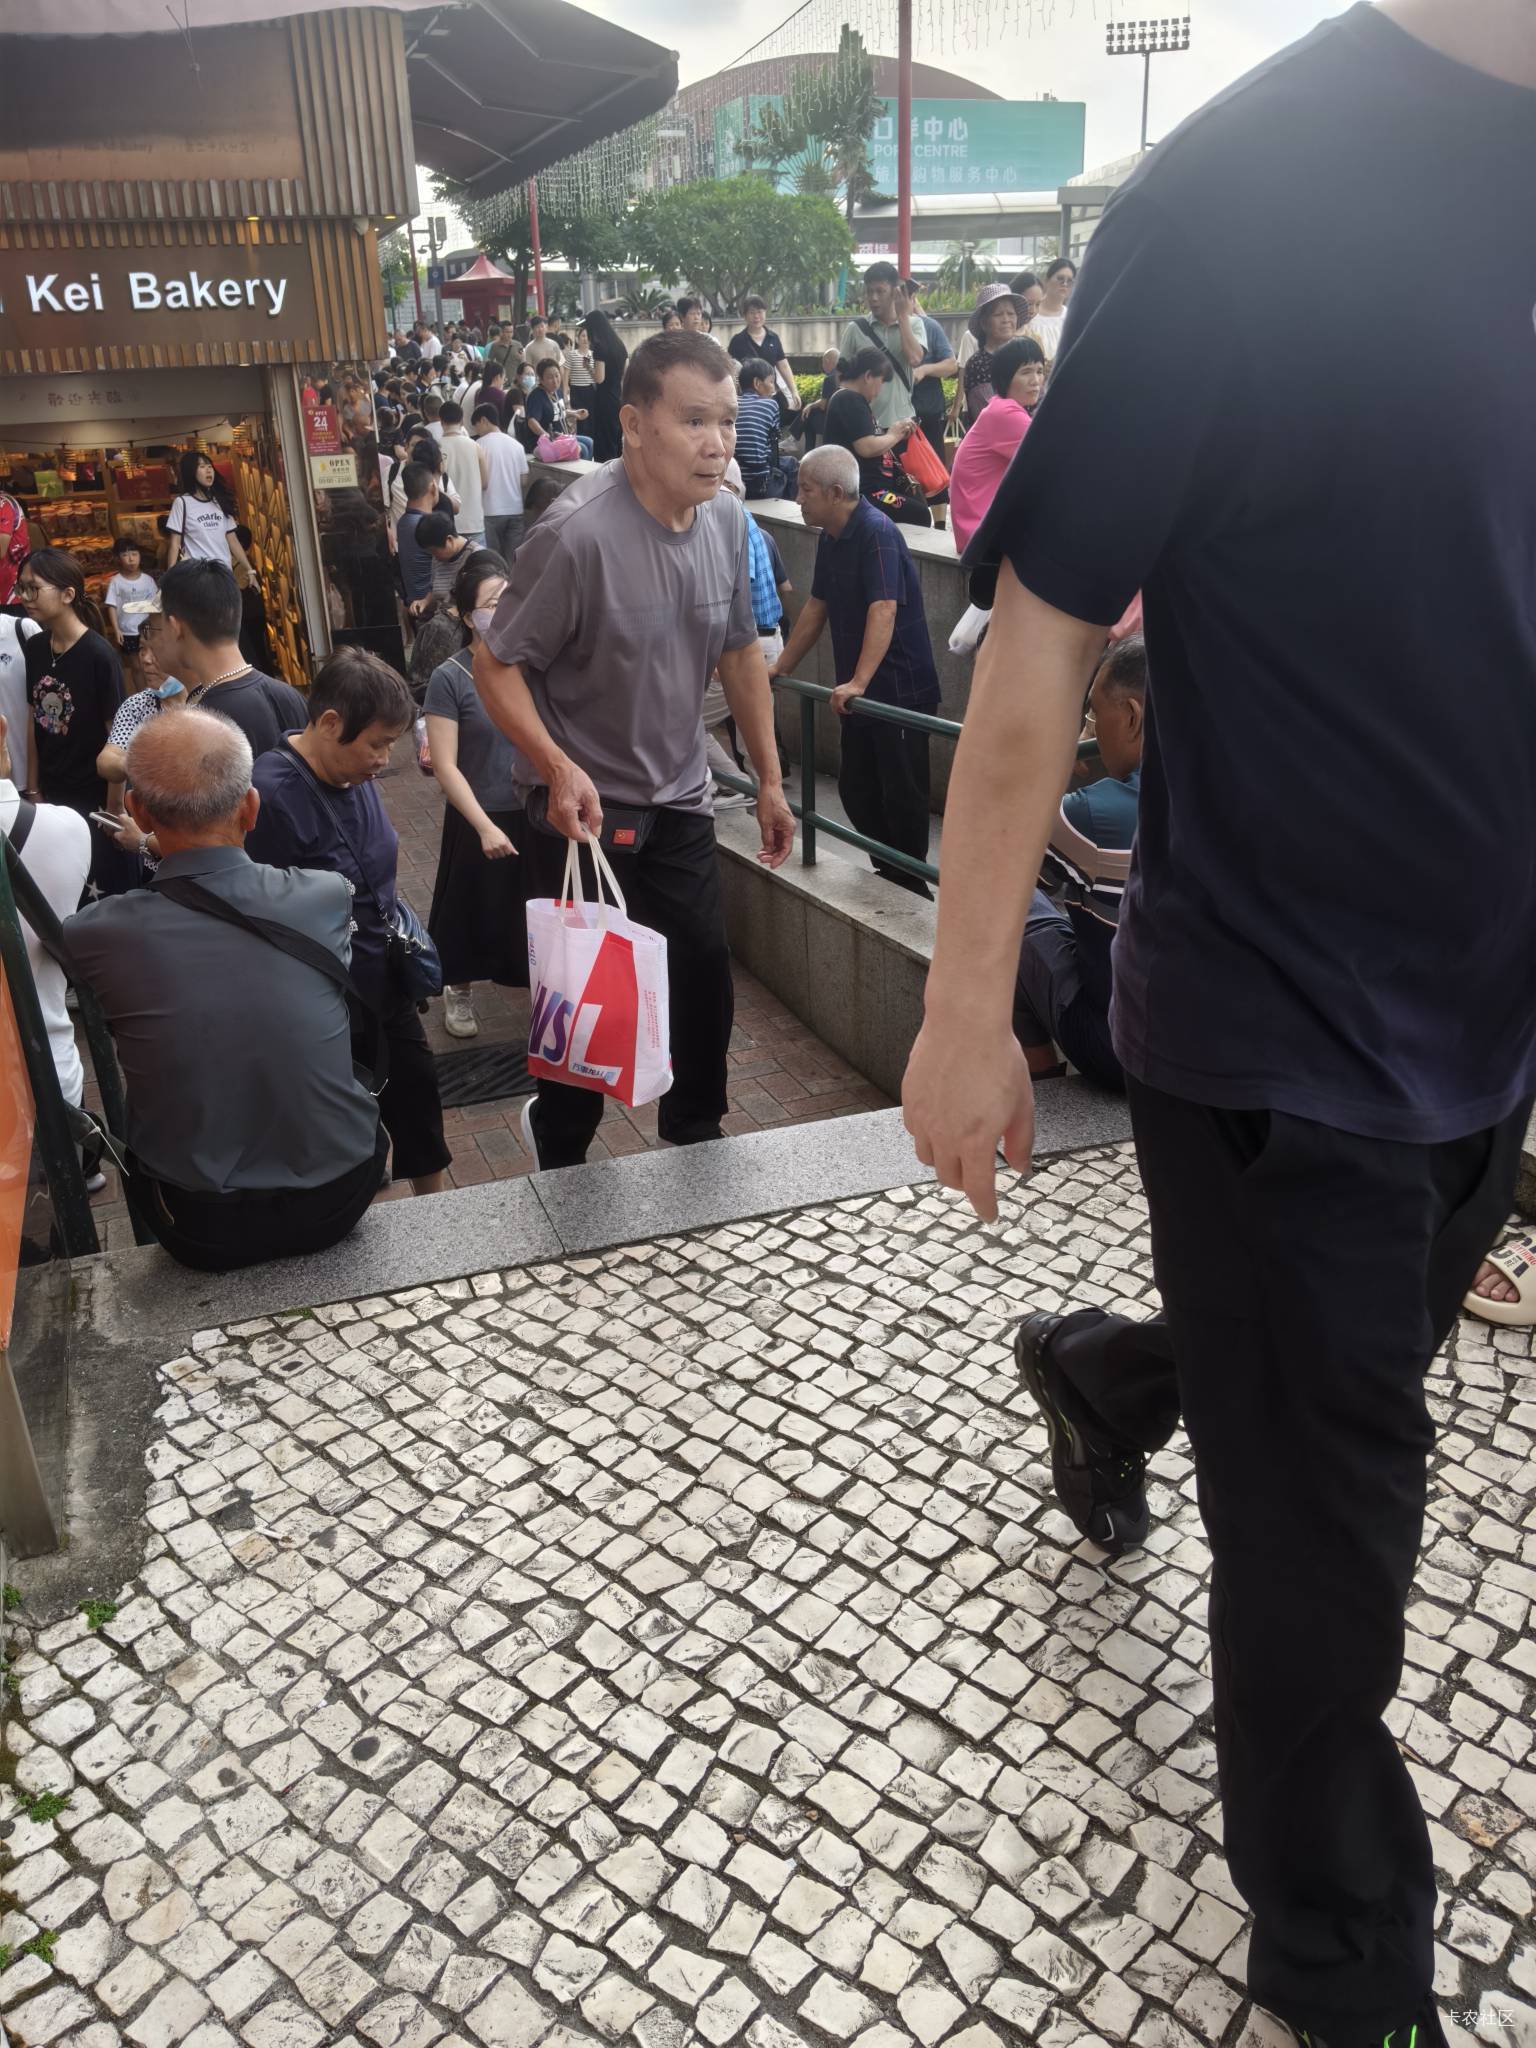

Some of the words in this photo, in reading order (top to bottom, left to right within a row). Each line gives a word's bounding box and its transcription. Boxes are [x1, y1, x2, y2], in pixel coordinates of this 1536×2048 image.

[873, 144, 899, 157] PO
[914, 144, 968, 158] CENTRE
[875, 166, 1018, 184] 旅购物服务中心
[26, 273, 104, 312] Kei
[129, 271, 287, 315] Bakery
